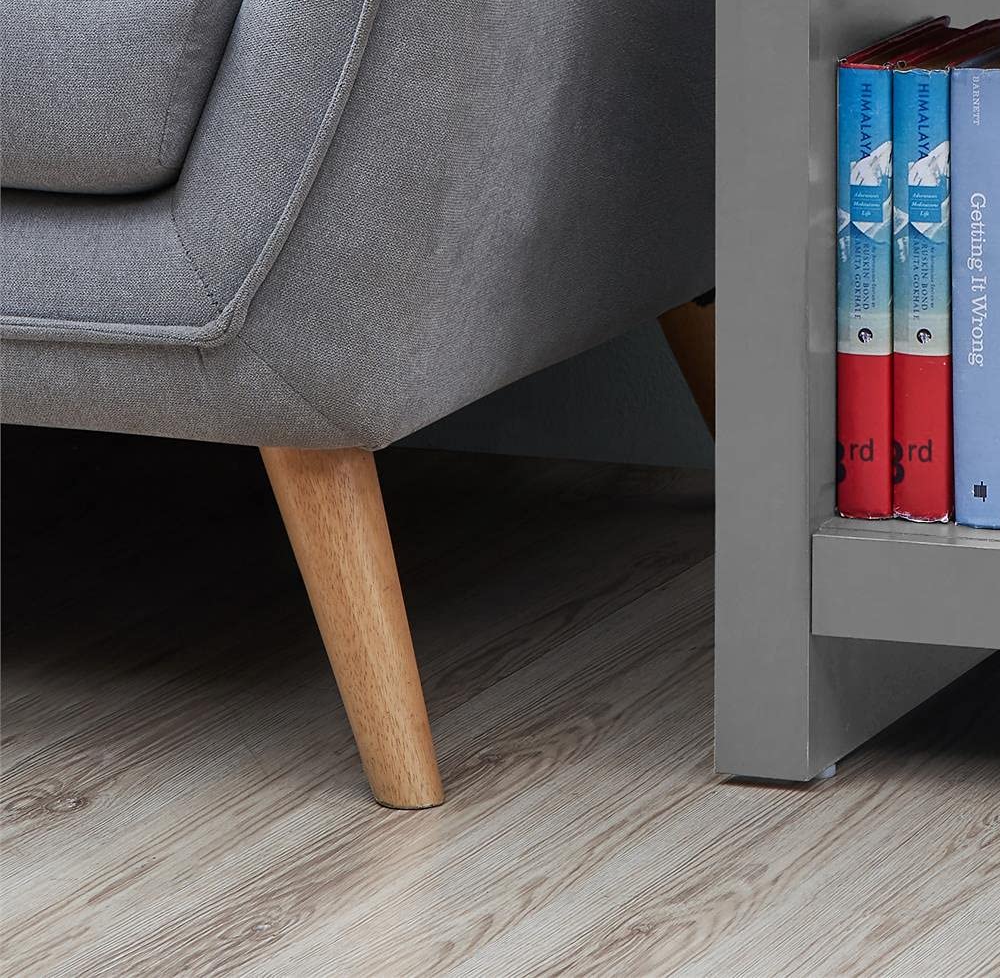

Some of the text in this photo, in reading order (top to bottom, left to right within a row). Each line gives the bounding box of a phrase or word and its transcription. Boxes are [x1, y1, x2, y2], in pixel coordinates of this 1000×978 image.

[860, 83, 872, 160] HIMALAYA
[917, 83, 930, 160] HIMALAYA
[972, 76, 980, 126] BARNETT
[862, 242, 870, 310] RUSKIN BOND
[921, 242, 929, 311] RUSKIN BOND
[967, 193, 988, 367] Getting It Wrong
